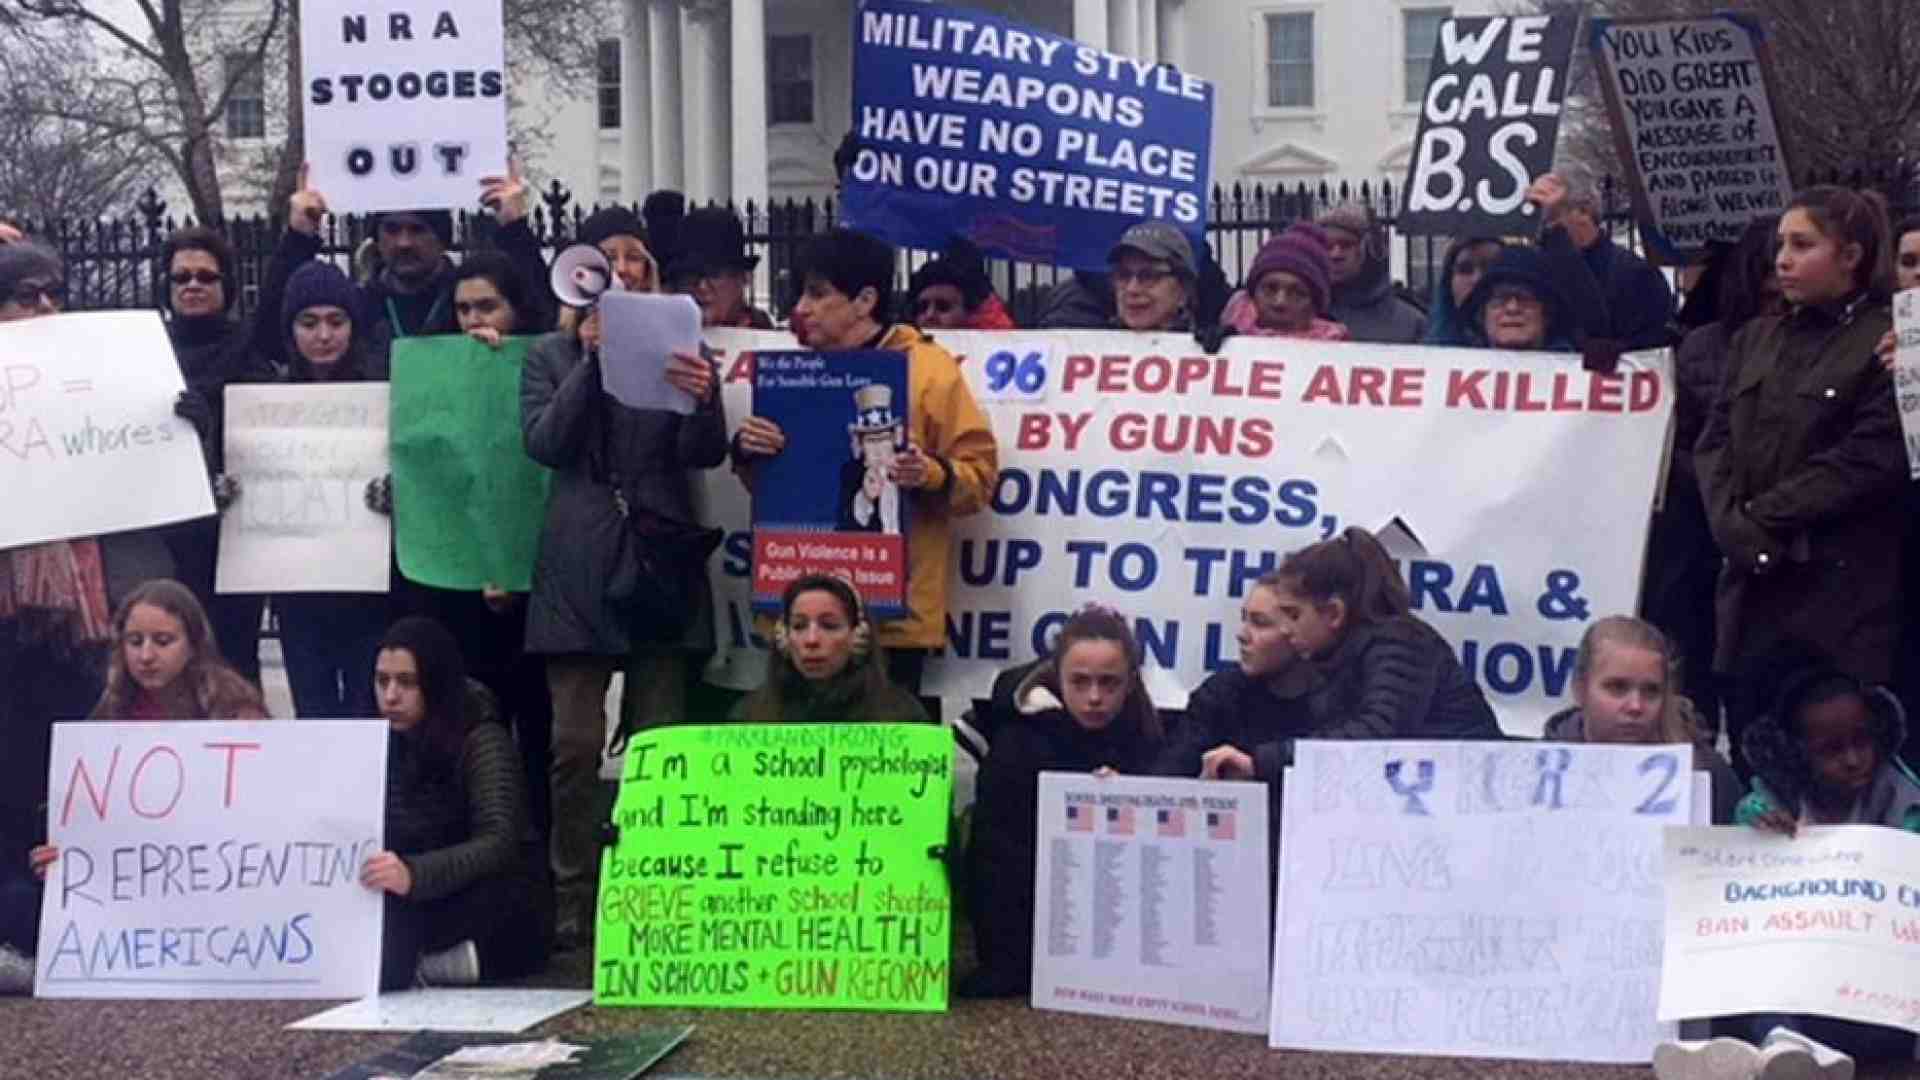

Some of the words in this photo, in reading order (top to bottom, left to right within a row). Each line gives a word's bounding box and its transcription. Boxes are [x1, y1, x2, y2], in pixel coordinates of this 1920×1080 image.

[342, 11, 460, 44] NRA
[1440, 16, 1550, 65] WE
[1601, 29, 1663, 62] YOU
[863, 11, 1066, 67] MILITARY
[1074, 45, 1209, 101] STYLE
[1672, 59, 1756, 93] GREAT
[311, 70, 503, 105] STOOGES
[912, 63, 1145, 128] WEAPONS
[1425, 66, 1561, 124] CALL
[1669, 97, 1727, 120] GAVE
[1734, 93, 1758, 117] A
[346, 142, 468, 176] OUT
[862, 106, 967, 149] HAVE
[979, 120, 1043, 157] NO
[1057, 128, 1197, 183] PLACE
[1408, 121, 1539, 215] B.S.
[853, 149, 903, 187] ON
[914, 156, 998, 197] OUR
[1010, 168, 1200, 223] STREETS
[985, 349, 1048, 394] 96
[1061, 354, 1286, 400] PEOPLE
[1300, 365, 1427, 407] ARE
[1445, 367, 1662, 414] KILLED
[61, 414, 175, 457] whores
[1016, 412, 1093, 452] BY
[1107, 412, 1275, 459] GUNS
[990, 467, 1338, 540] ONGRESS,
[765, 541, 796, 560] Gun
[797, 542, 859, 562] Violence
[958, 539, 1042, 587] UP
[1065, 541, 1159, 592] TO
[1183, 547, 1277, 598] TH
[1400, 560, 1509, 616] RA
[1537, 569, 1591, 622] &
[1030, 610, 1180, 670] GN
[59, 742, 262, 828] NOT
[710, 752, 732, 777] a
[1633, 752, 1680, 816] 2
[677, 793, 728, 828] I'm
[742, 795, 841, 840] standing
[850, 795, 904, 828] here
[610, 846, 707, 881] because
[714, 843, 745, 880] I
[755, 838, 839, 878] refuse
[854, 841, 884, 877] to
[601, 882, 696, 925] GRIEVE
[700, 886, 779, 915] another
[1724, 879, 1887, 903] BACKGROUND
[44, 912, 314, 977] AMERICANS
[628, 922, 696, 959] MORE
[702, 916, 791, 952] MENTAL
[798, 915, 923, 957] HEALTH
[1696, 917, 1749, 938] BAN
[1764, 910, 1877, 933] ASSAULT
[600, 959, 640, 998] IN
[646, 960, 749, 996] SCHOOLS
[774, 958, 840, 998] GUN
[846, 959, 948, 1003] REFORM
